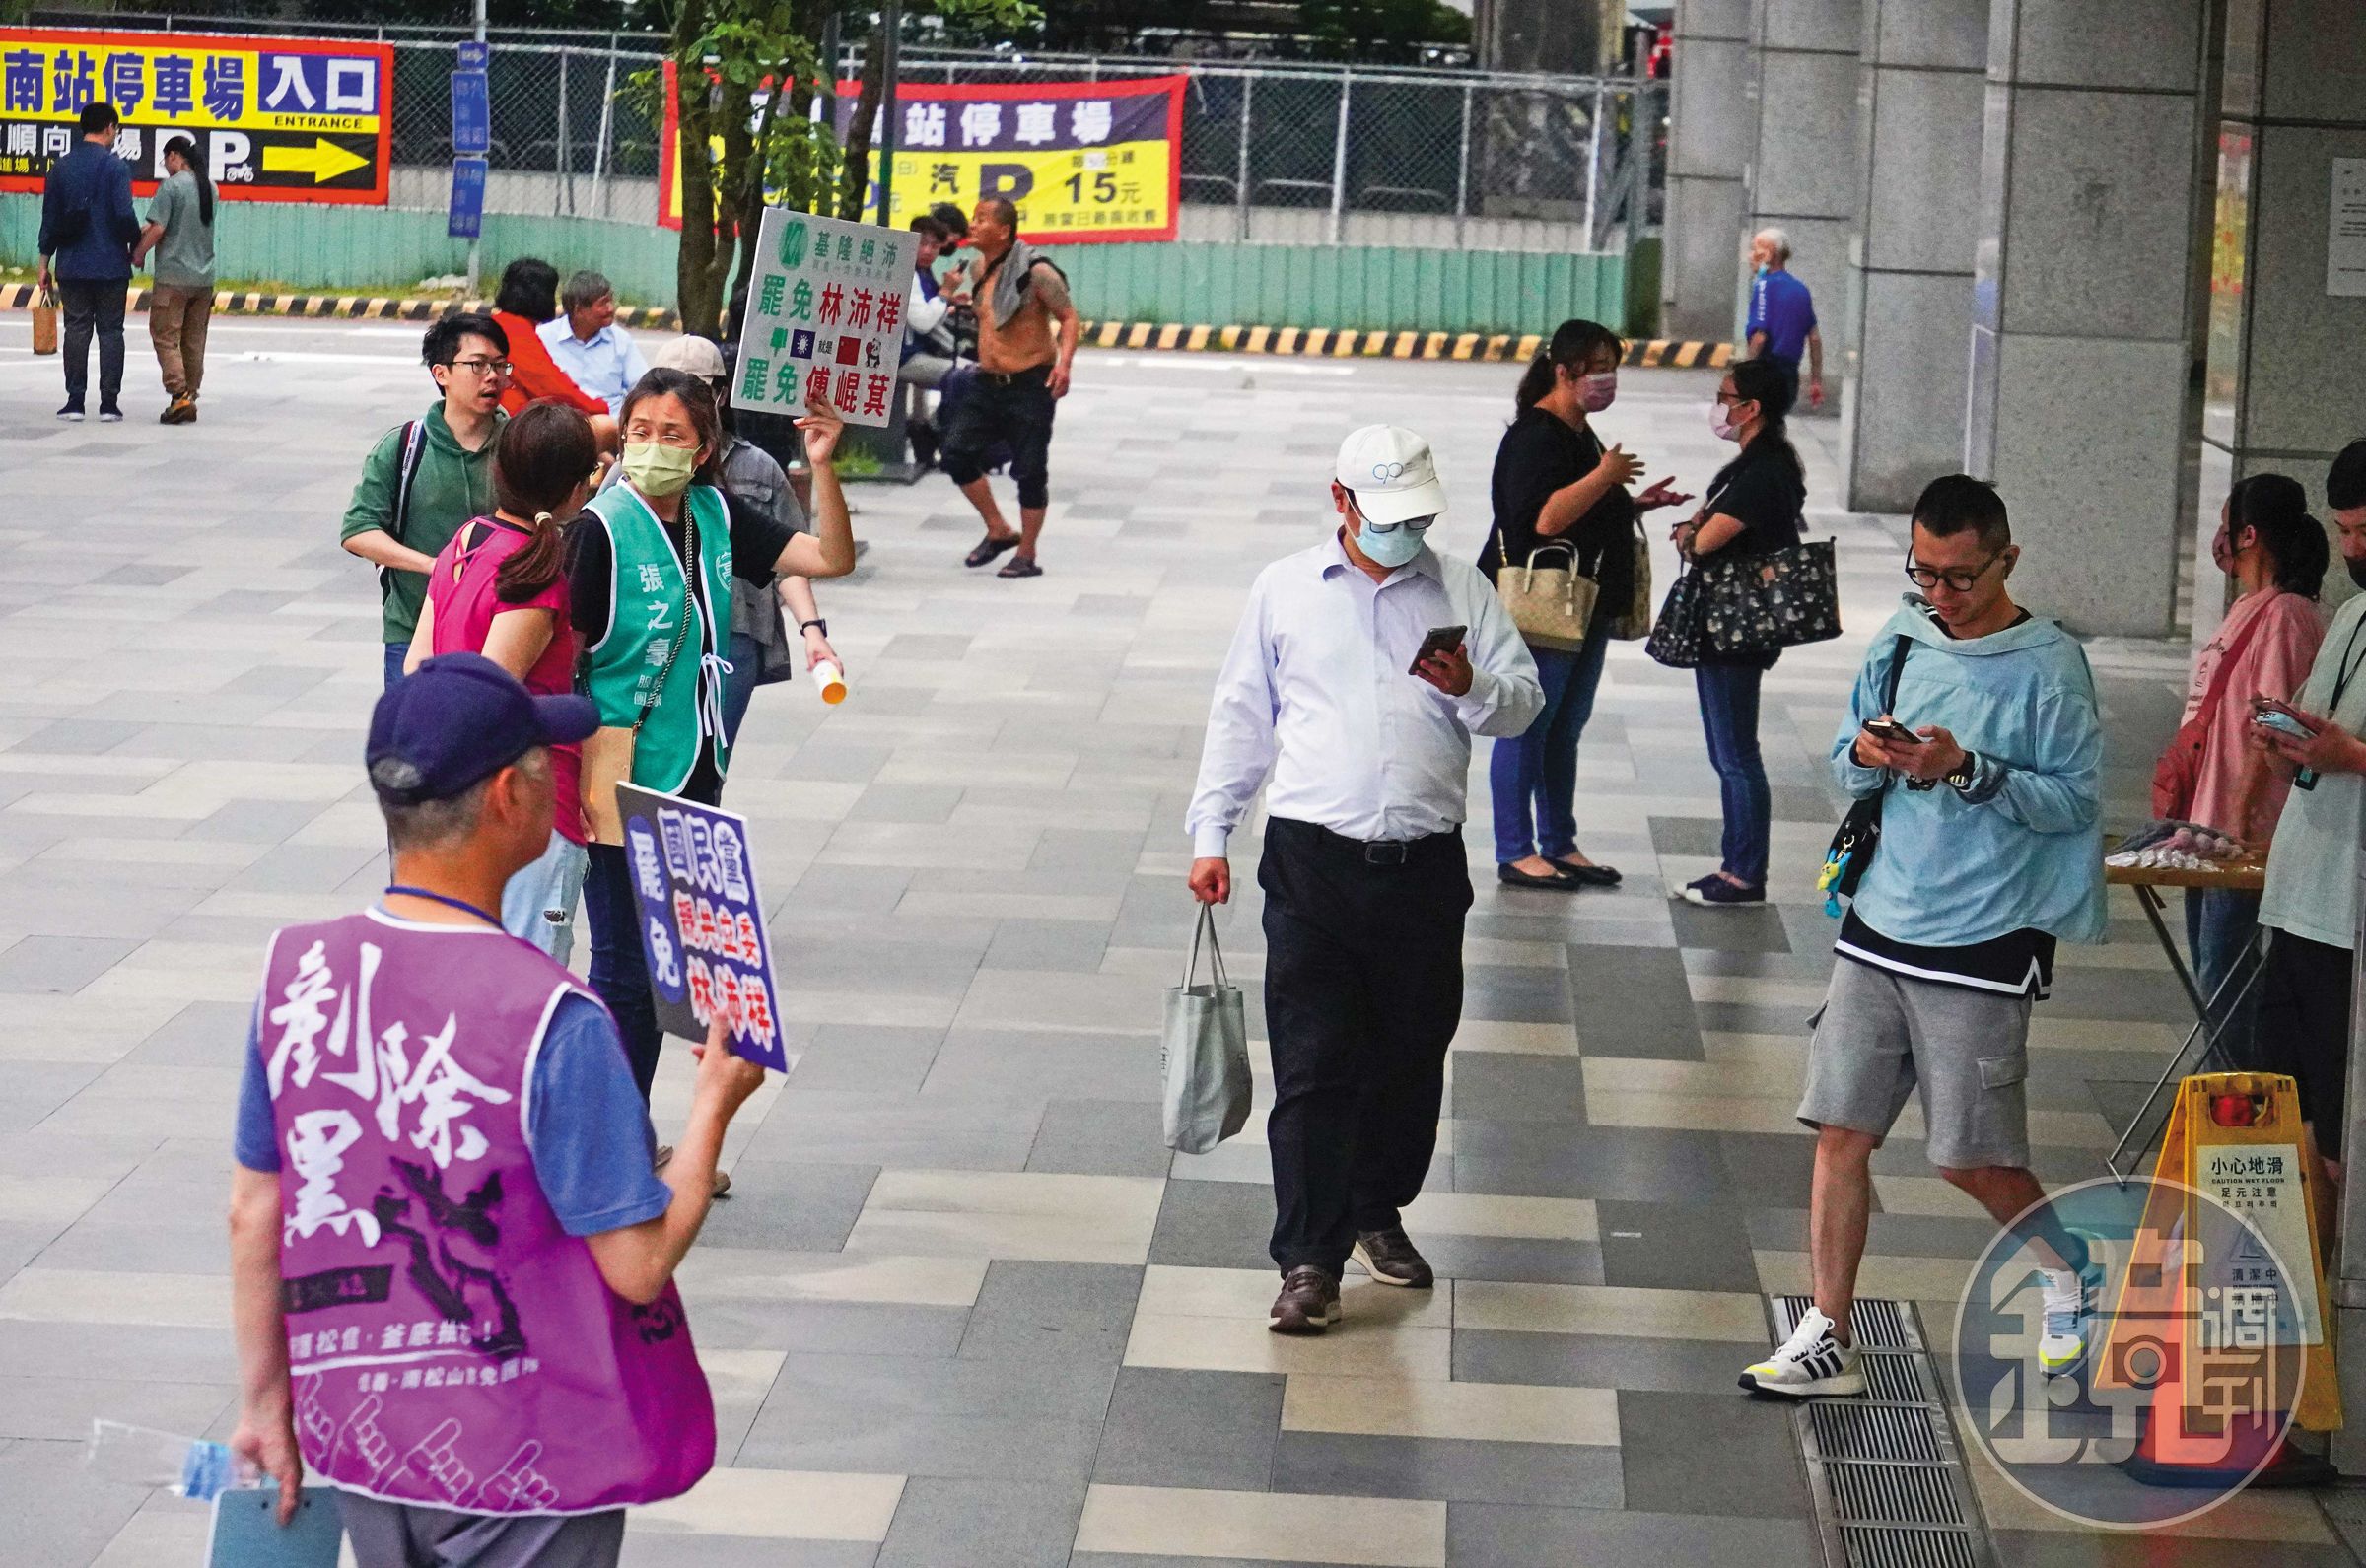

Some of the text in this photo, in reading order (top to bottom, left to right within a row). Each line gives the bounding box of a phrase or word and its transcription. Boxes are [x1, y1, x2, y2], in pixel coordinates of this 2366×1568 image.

[4, 49, 244, 121] 南站停車場
[266, 55, 376, 112] 入口
[274, 115, 363, 129] ENTRANCE
[209, 131, 251, 181] P
[817, 339, 833, 355] 就是
[657, 807, 749, 905] 國民黨
[630, 829, 681, 988] 罷免
[2211, 1156, 2284, 1175] 小心地滑
[2221, 1187, 2277, 1198] 足元注意
